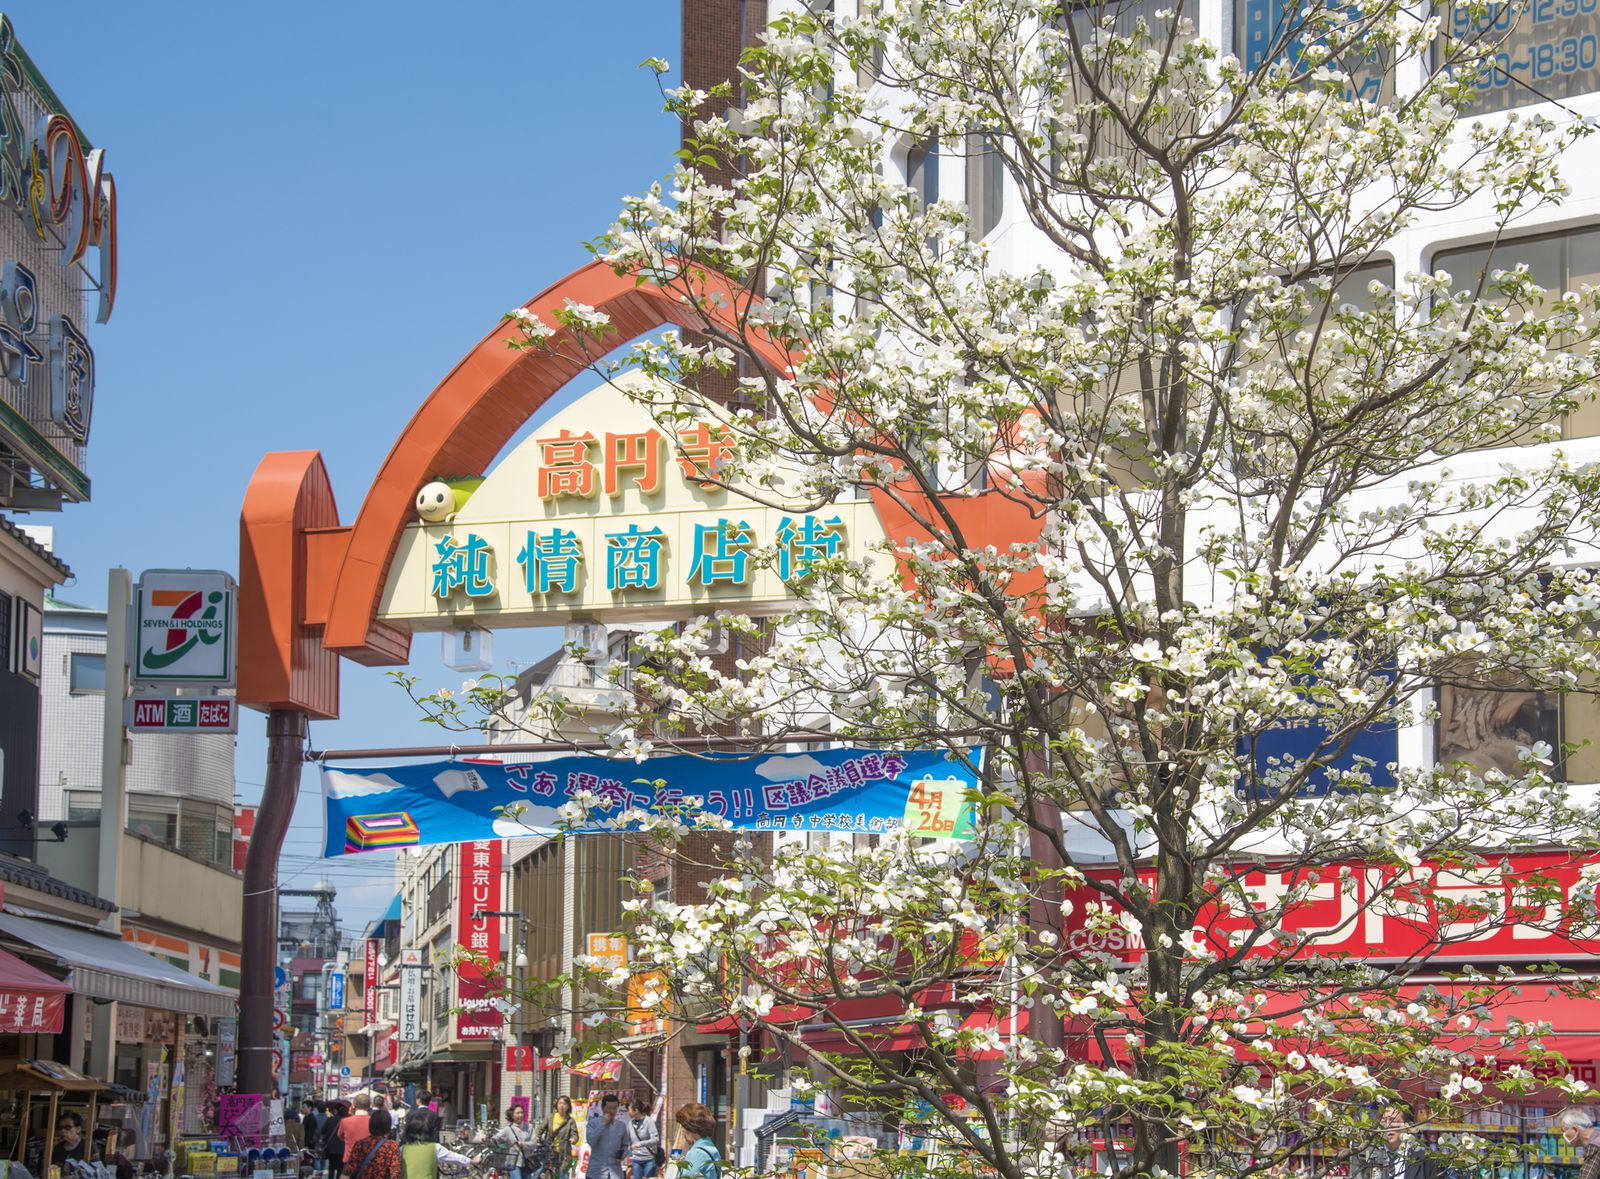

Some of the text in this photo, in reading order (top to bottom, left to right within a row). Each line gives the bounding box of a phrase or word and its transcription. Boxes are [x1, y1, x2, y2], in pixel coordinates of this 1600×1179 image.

[535, 421, 737, 499] 高円寺
[431, 514, 843, 599] 純情商店街
[143, 619, 169, 629] SEVEN
[180, 619, 224, 629] HOLDINGS
[136, 702, 164, 724] ATM
[172, 703, 193, 725] 酒
[200, 704, 229, 724] たばこ
[503, 763, 559, 798] さあ
[762, 752, 909, 812] 区議会議員選挙
[907, 781, 943, 811] 4月
[917, 810, 955, 833] 26日
[405, 1004, 416, 1041] はせがわ
